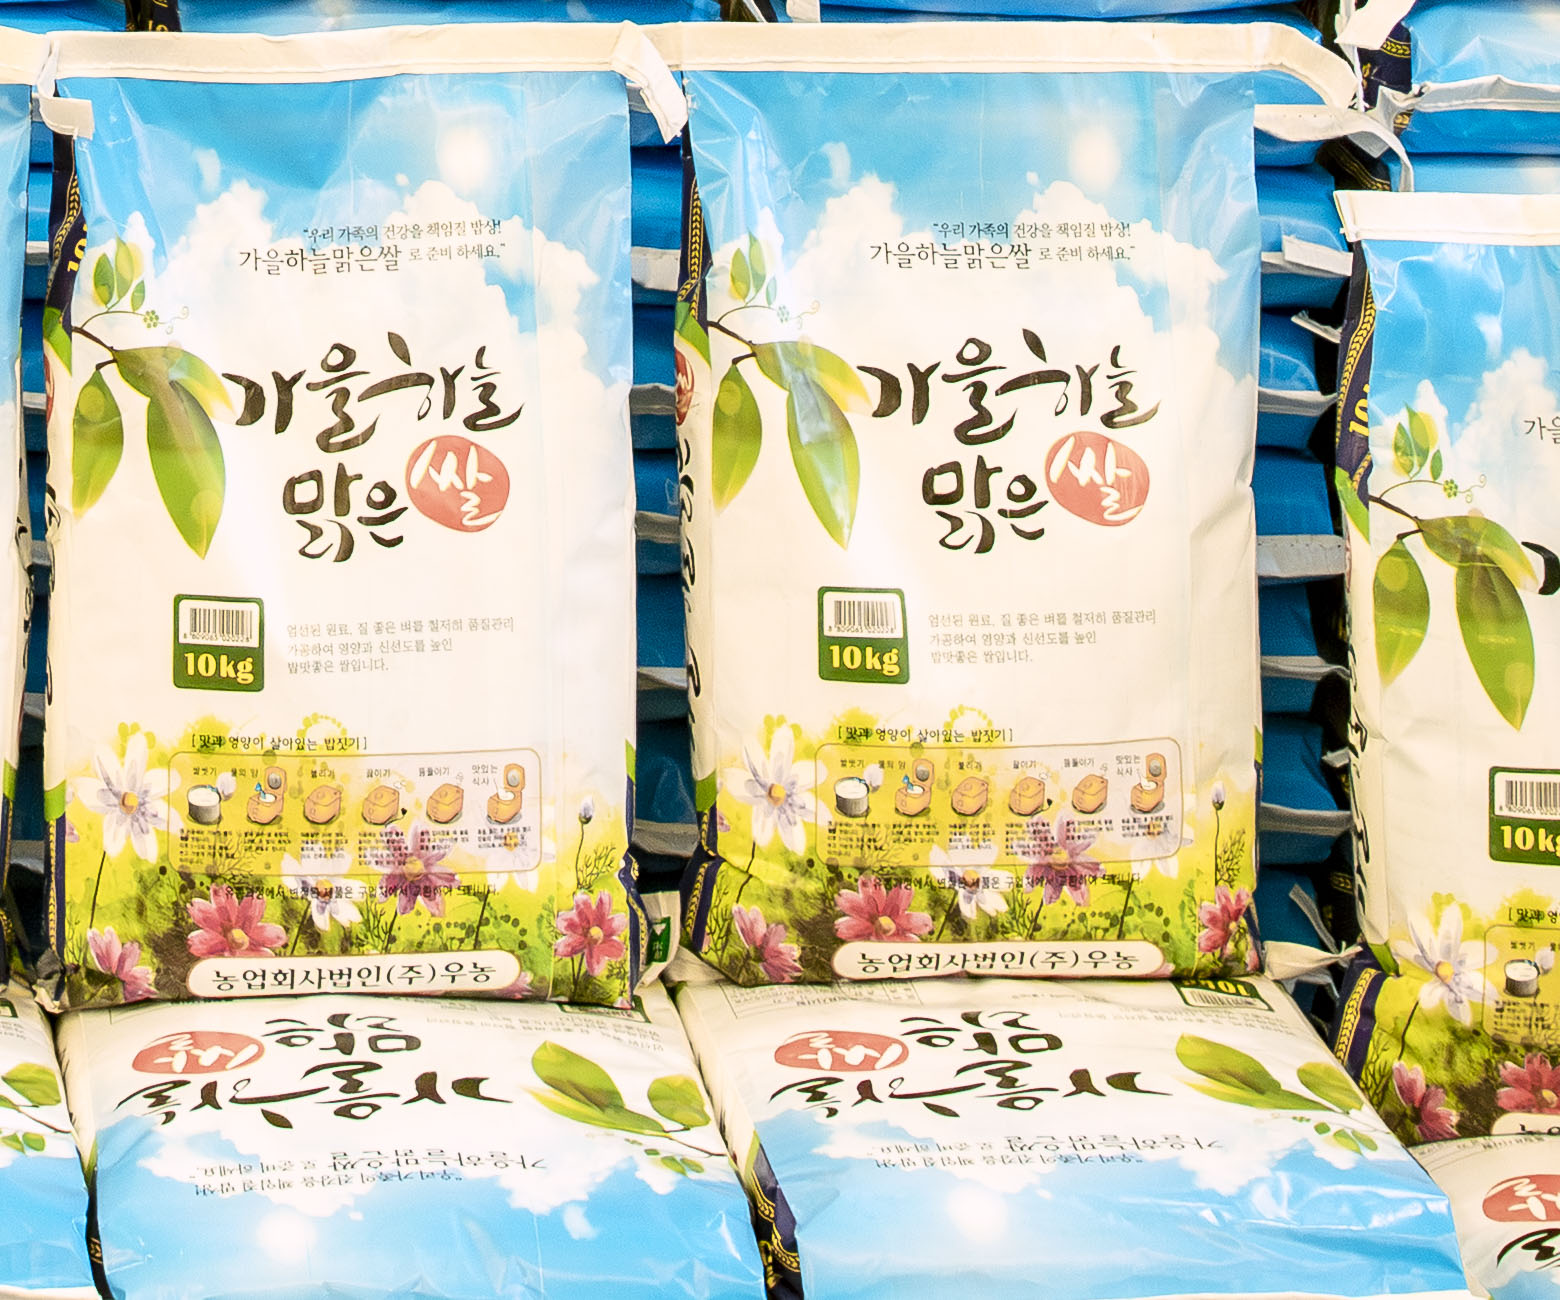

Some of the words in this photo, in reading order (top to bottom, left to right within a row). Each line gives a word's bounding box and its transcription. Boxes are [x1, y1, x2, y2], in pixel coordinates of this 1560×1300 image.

[338, 225, 378, 241] 가족의
[383, 224, 421, 240] 건강을
[427, 222, 467, 238] 책임질
[471, 220, 501, 236] 밥상!
[968, 222, 1009, 238] 가족의
[1014, 222, 1052, 238] 건강을
[1057, 222, 1096, 238] 책임질
[1100, 221, 1131, 237] 밥상!
[239, 245, 402, 275] 가을하늘맑은쌀
[426, 246, 452, 261] 준비
[870, 242, 1032, 270] 가을하늘맑은쌀
[1056, 246, 1083, 262] 준비
[222, 331, 525, 453] 가을하늘
[857, 328, 1161, 445] 가을하늘
[282, 462, 409, 562] 맑은
[922, 455, 1048, 554] 맑은
[184, 652, 254, 685] 10kg
[830, 645, 899, 676] 10kg
[212, 961, 496, 992] 농업회사법인(주)우농
[857, 949, 1139, 974] 농업회사법인(주)우농
